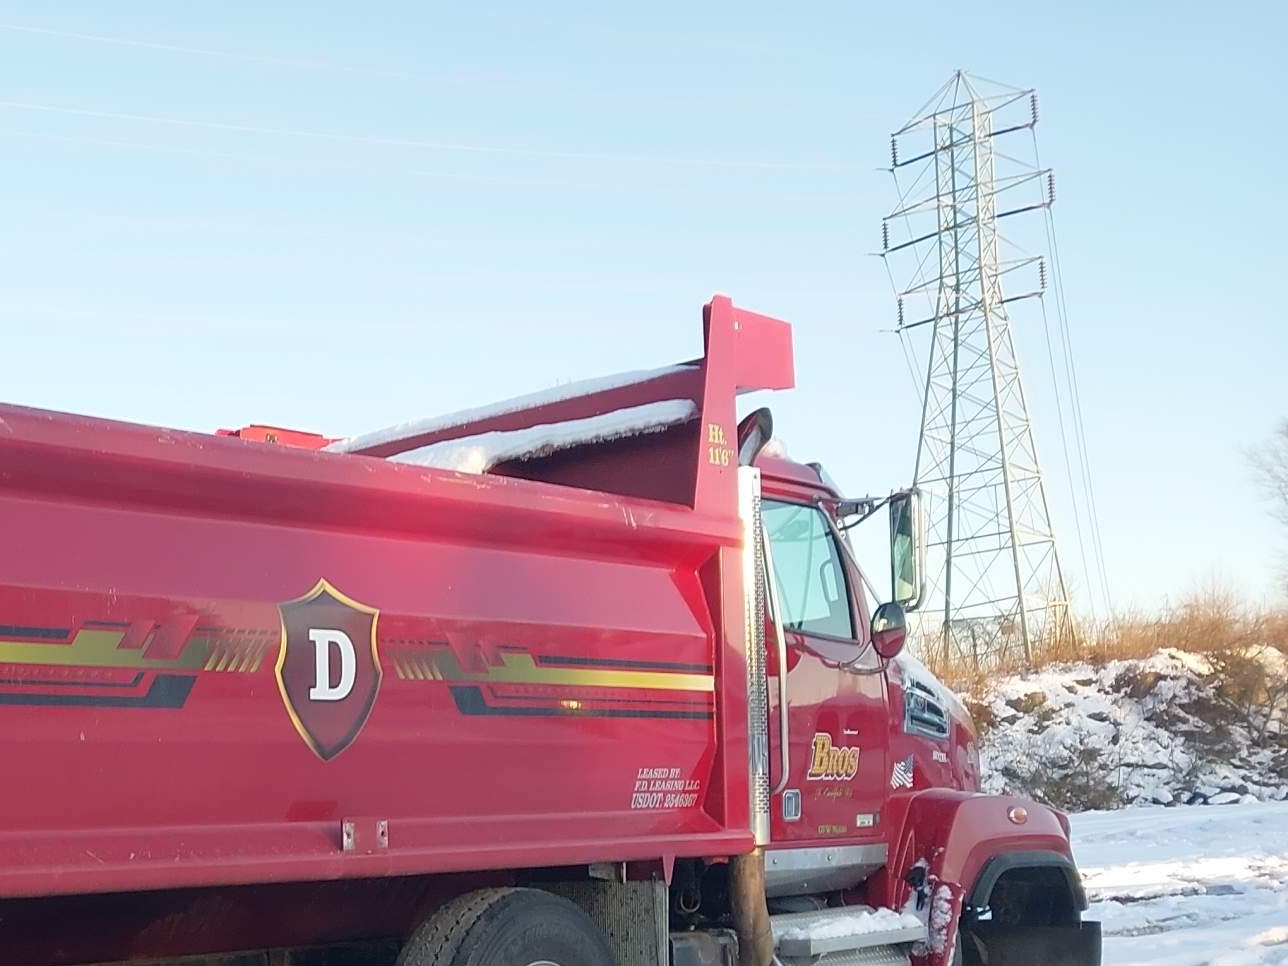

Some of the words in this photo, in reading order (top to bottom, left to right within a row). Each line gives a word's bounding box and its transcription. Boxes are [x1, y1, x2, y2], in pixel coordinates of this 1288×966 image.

[308, 628, 357, 701] D
[637, 767, 668, 780] LEASED
[649, 780, 684, 792] LEASING
[631, 793, 663, 809] USDOT:
